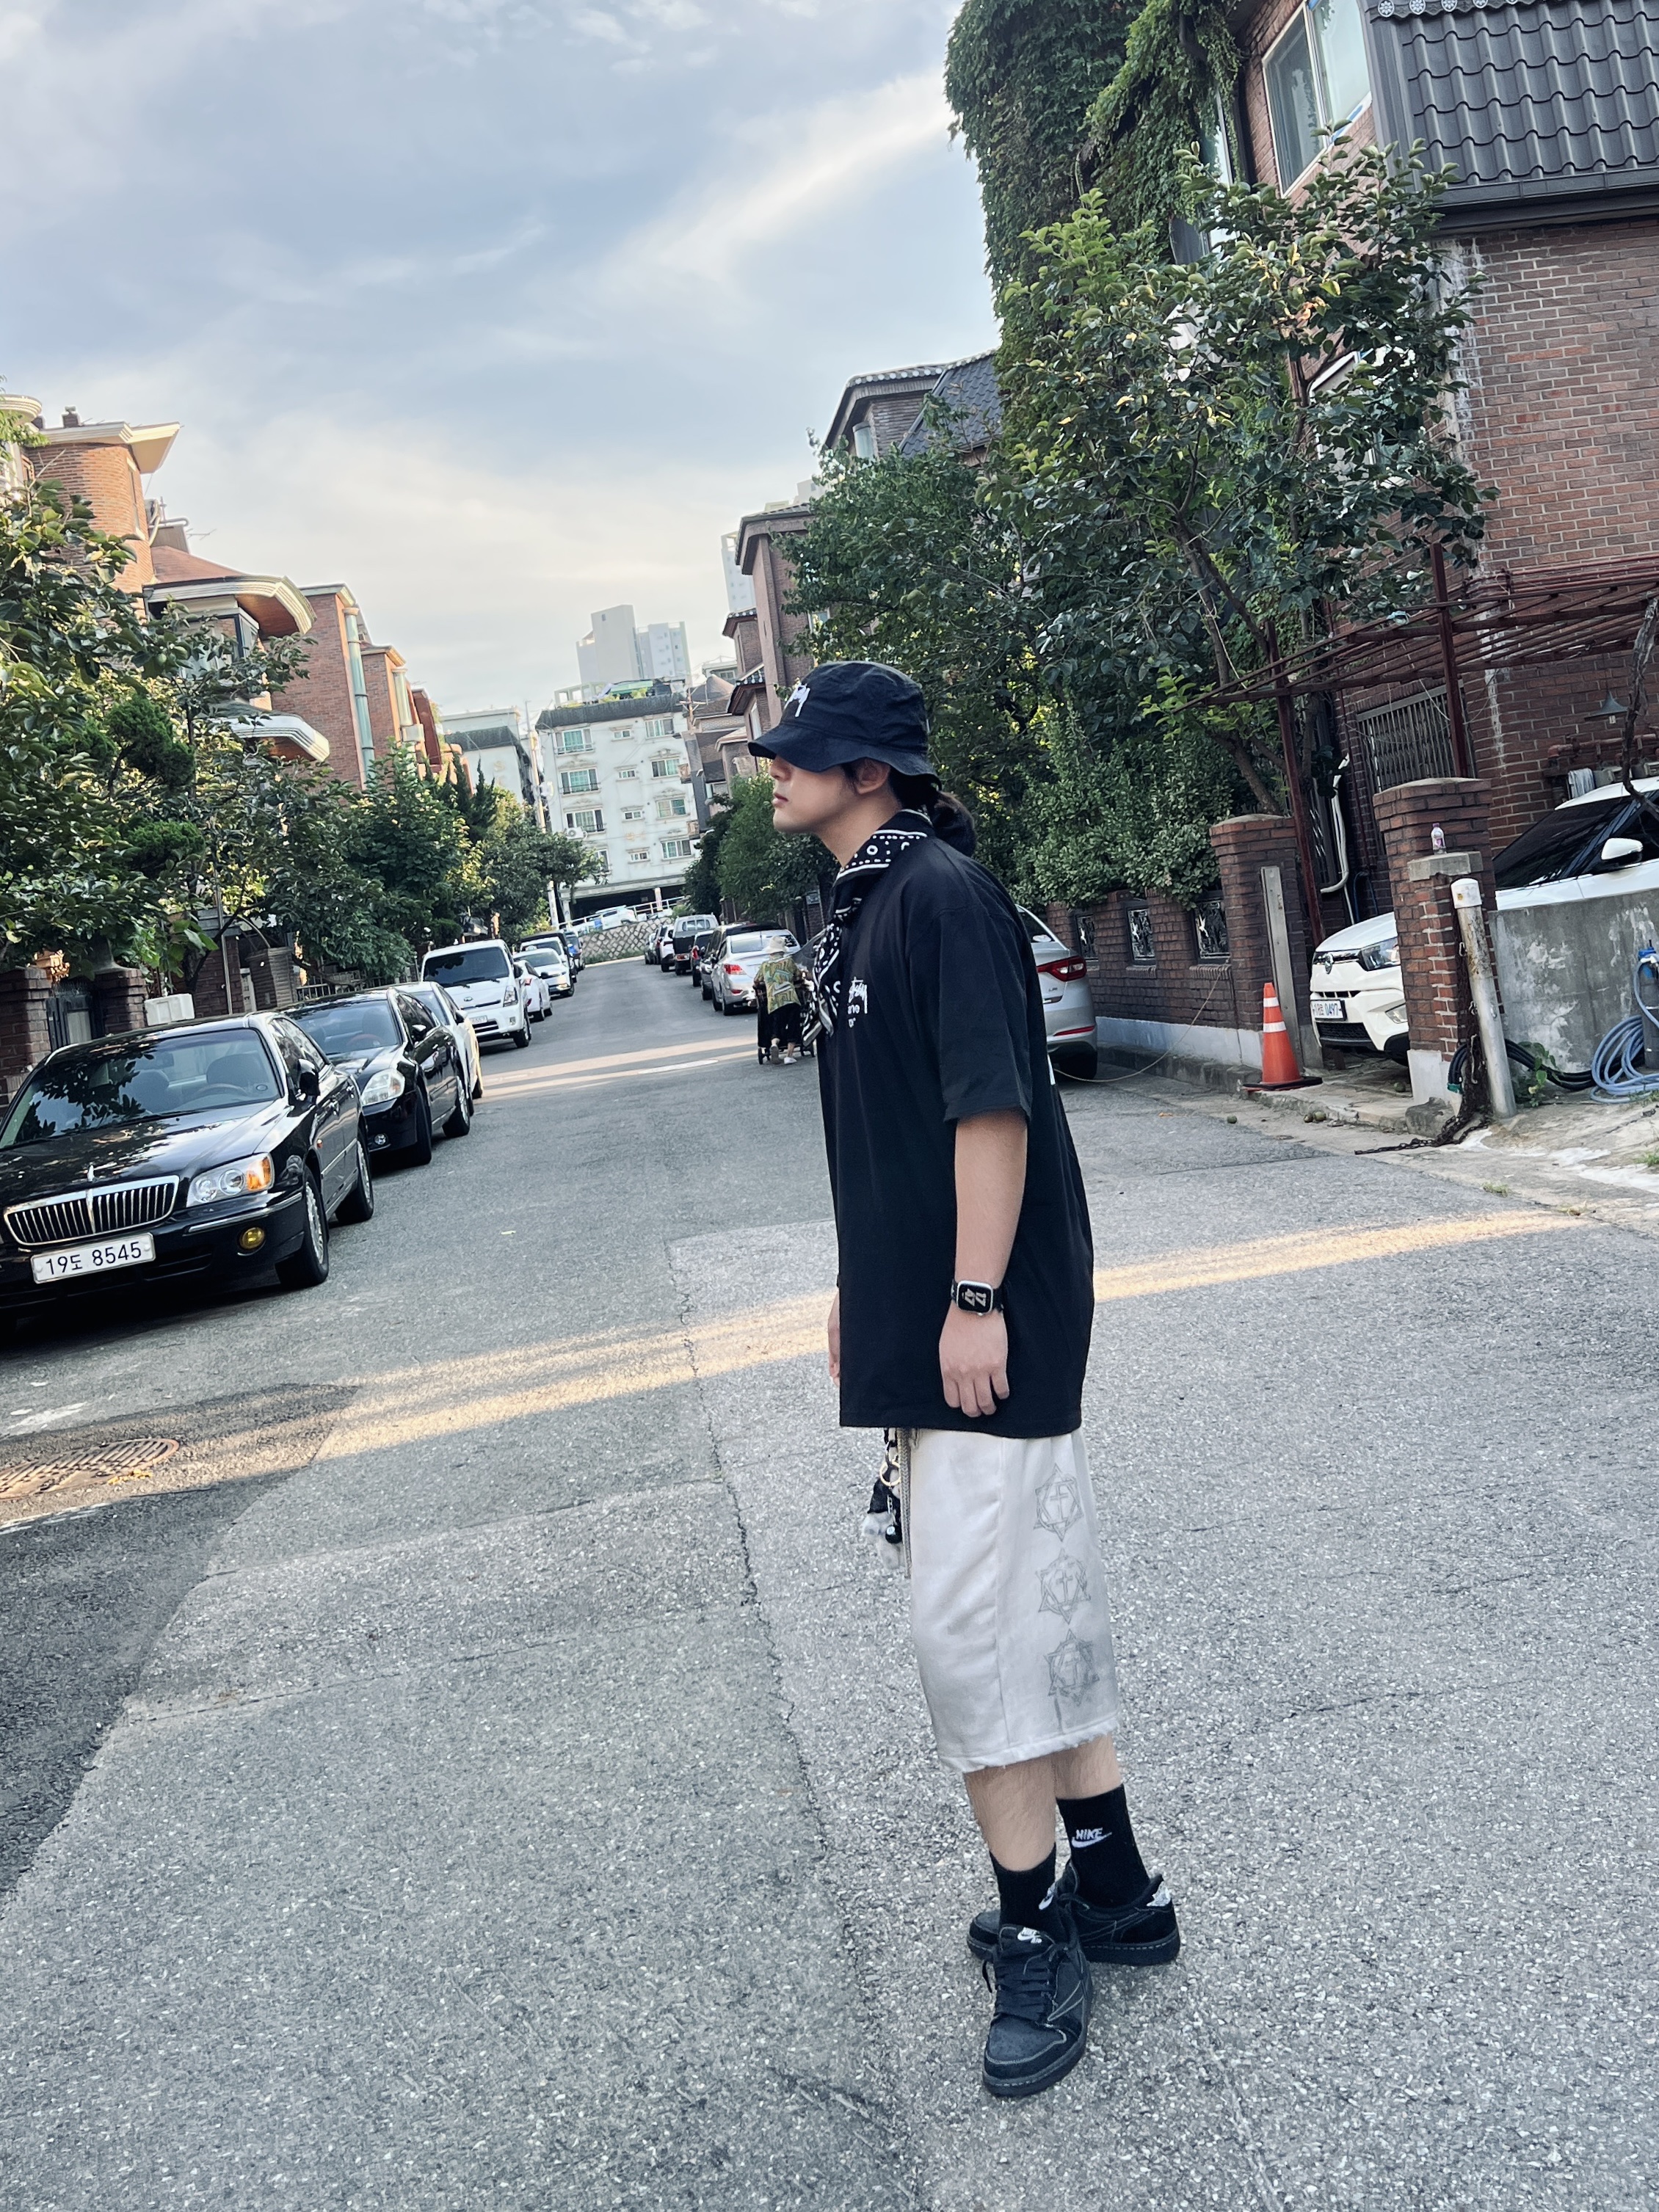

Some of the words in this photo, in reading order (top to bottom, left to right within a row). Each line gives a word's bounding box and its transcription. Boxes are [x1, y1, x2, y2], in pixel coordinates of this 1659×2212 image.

[46, 1254, 83, 1276] 19도
[92, 1241, 142, 1267] 8545
[1075, 1827, 1103, 1840] NIKE
